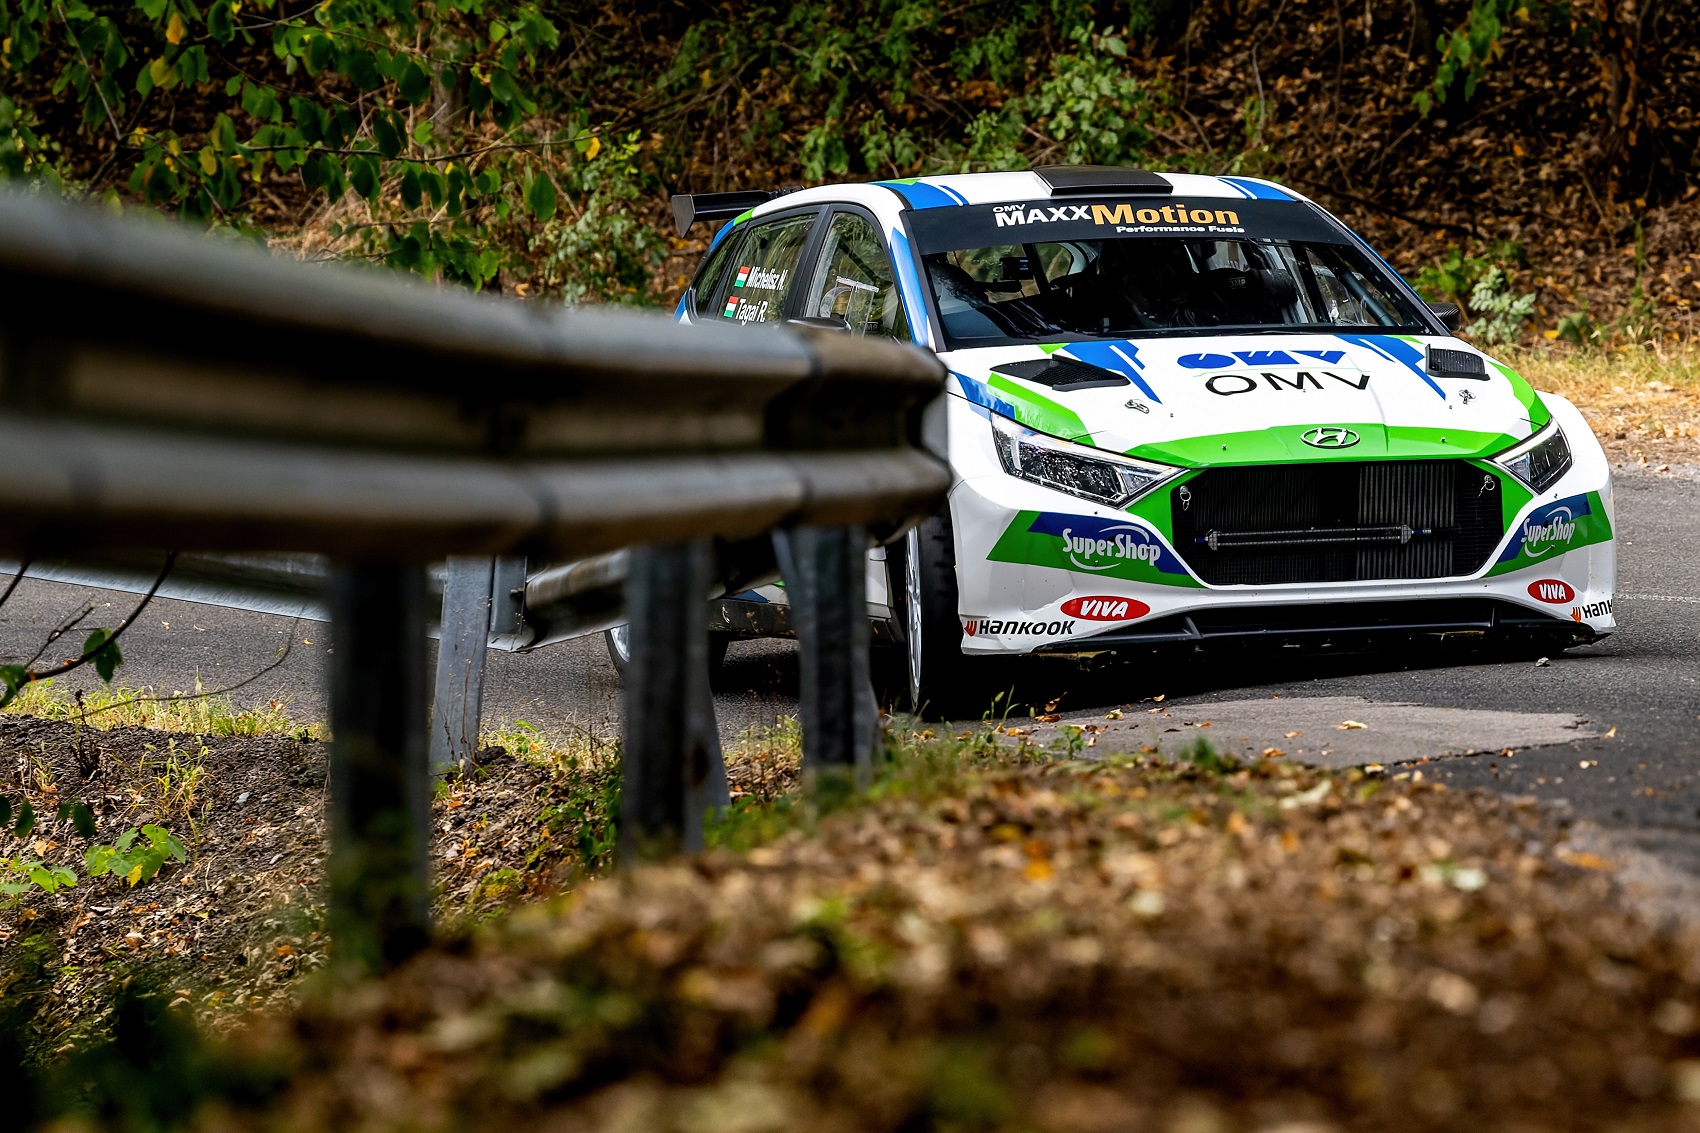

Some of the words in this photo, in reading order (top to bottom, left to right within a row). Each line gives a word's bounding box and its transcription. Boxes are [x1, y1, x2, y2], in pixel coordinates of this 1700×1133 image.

[992, 203, 1026, 213] OMV
[1116, 225, 1206, 234] Performance
[1208, 225, 1245, 234] Fuels
[736, 299, 761, 325] Tagai
[1205, 371, 1371, 397] OMV
[1521, 516, 1575, 547] SuperShop
[1062, 528, 1162, 567] SuperShop
[1539, 583, 1566, 600] VIVA
[1080, 600, 1129, 618] VIVA
